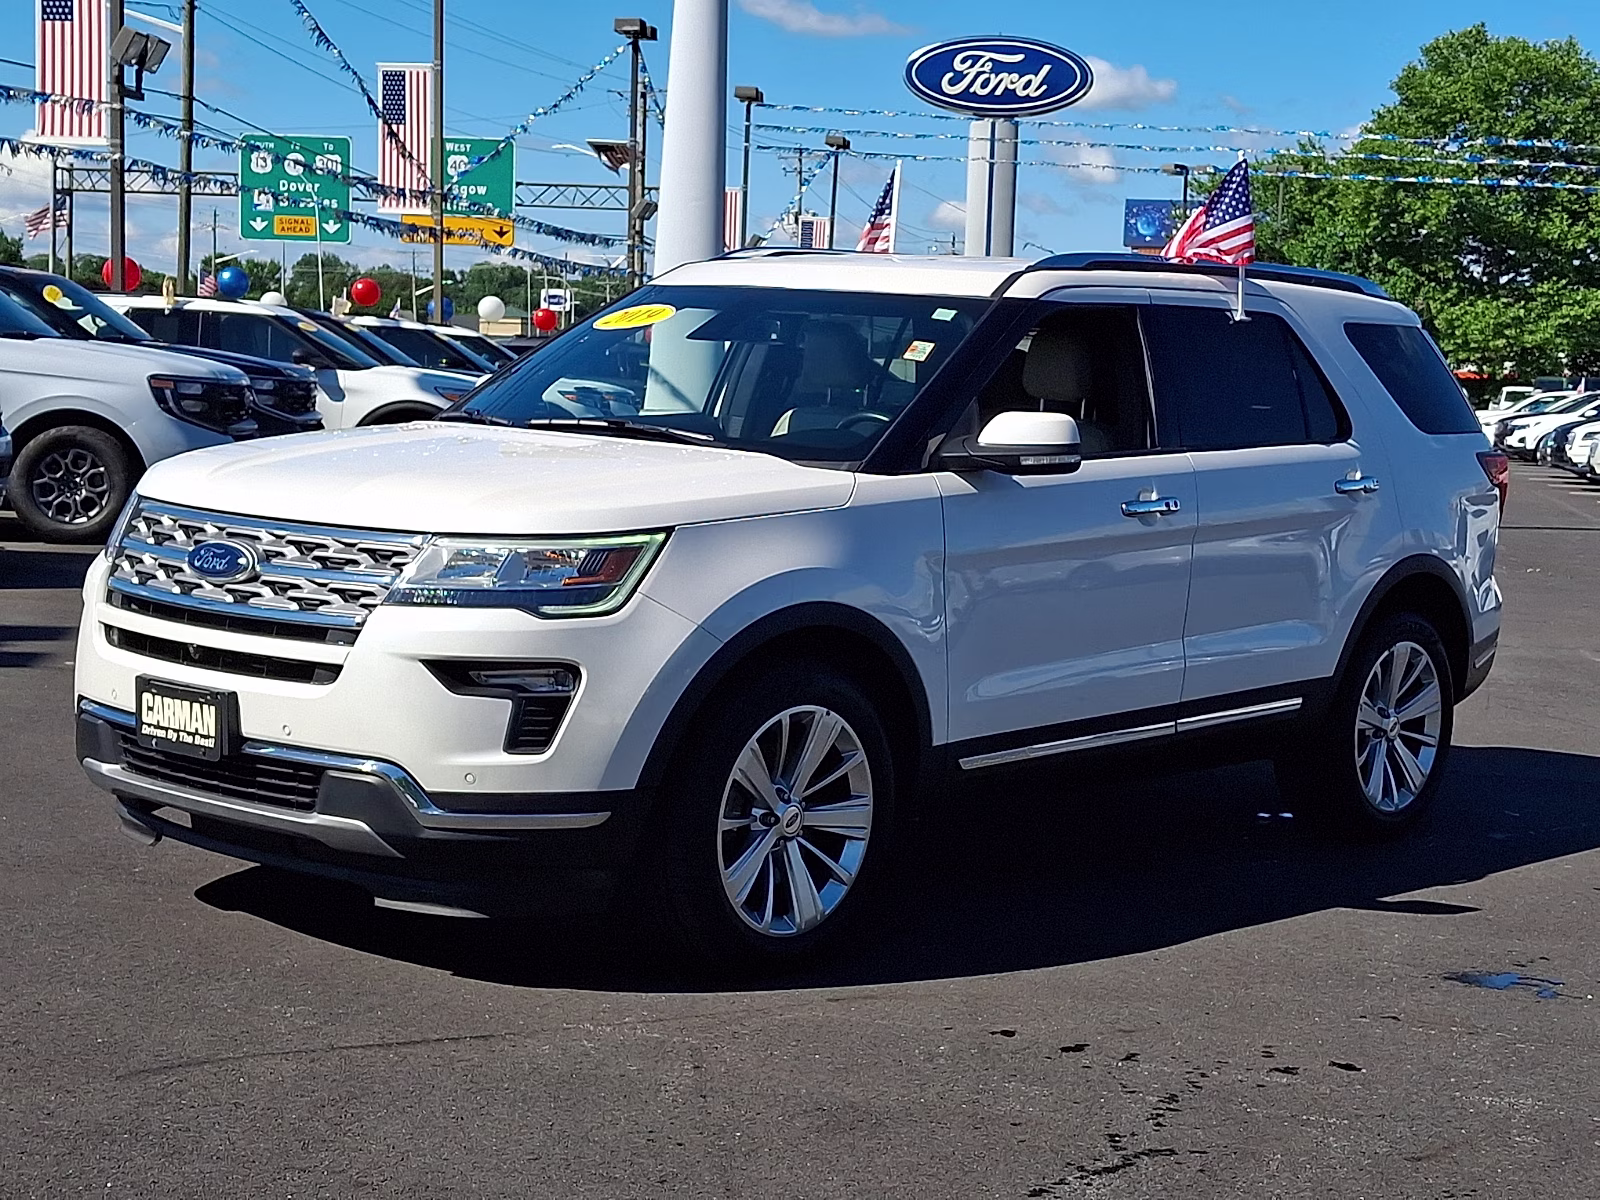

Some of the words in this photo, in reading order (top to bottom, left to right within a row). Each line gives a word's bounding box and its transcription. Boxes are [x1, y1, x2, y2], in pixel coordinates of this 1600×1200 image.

[941, 50, 1052, 98] Ford
[322, 142, 334, 151] TO
[445, 142, 472, 153] WEST
[279, 179, 321, 193] Dover
[279, 217, 312, 226] SIGNAL
[280, 226, 311, 234] AHEAD
[194, 547, 231, 570] Ford
[141, 691, 216, 738] CARMAN
[141, 723, 167, 738] Driven
[167, 728, 178, 743] By
[179, 731, 194, 744] The
